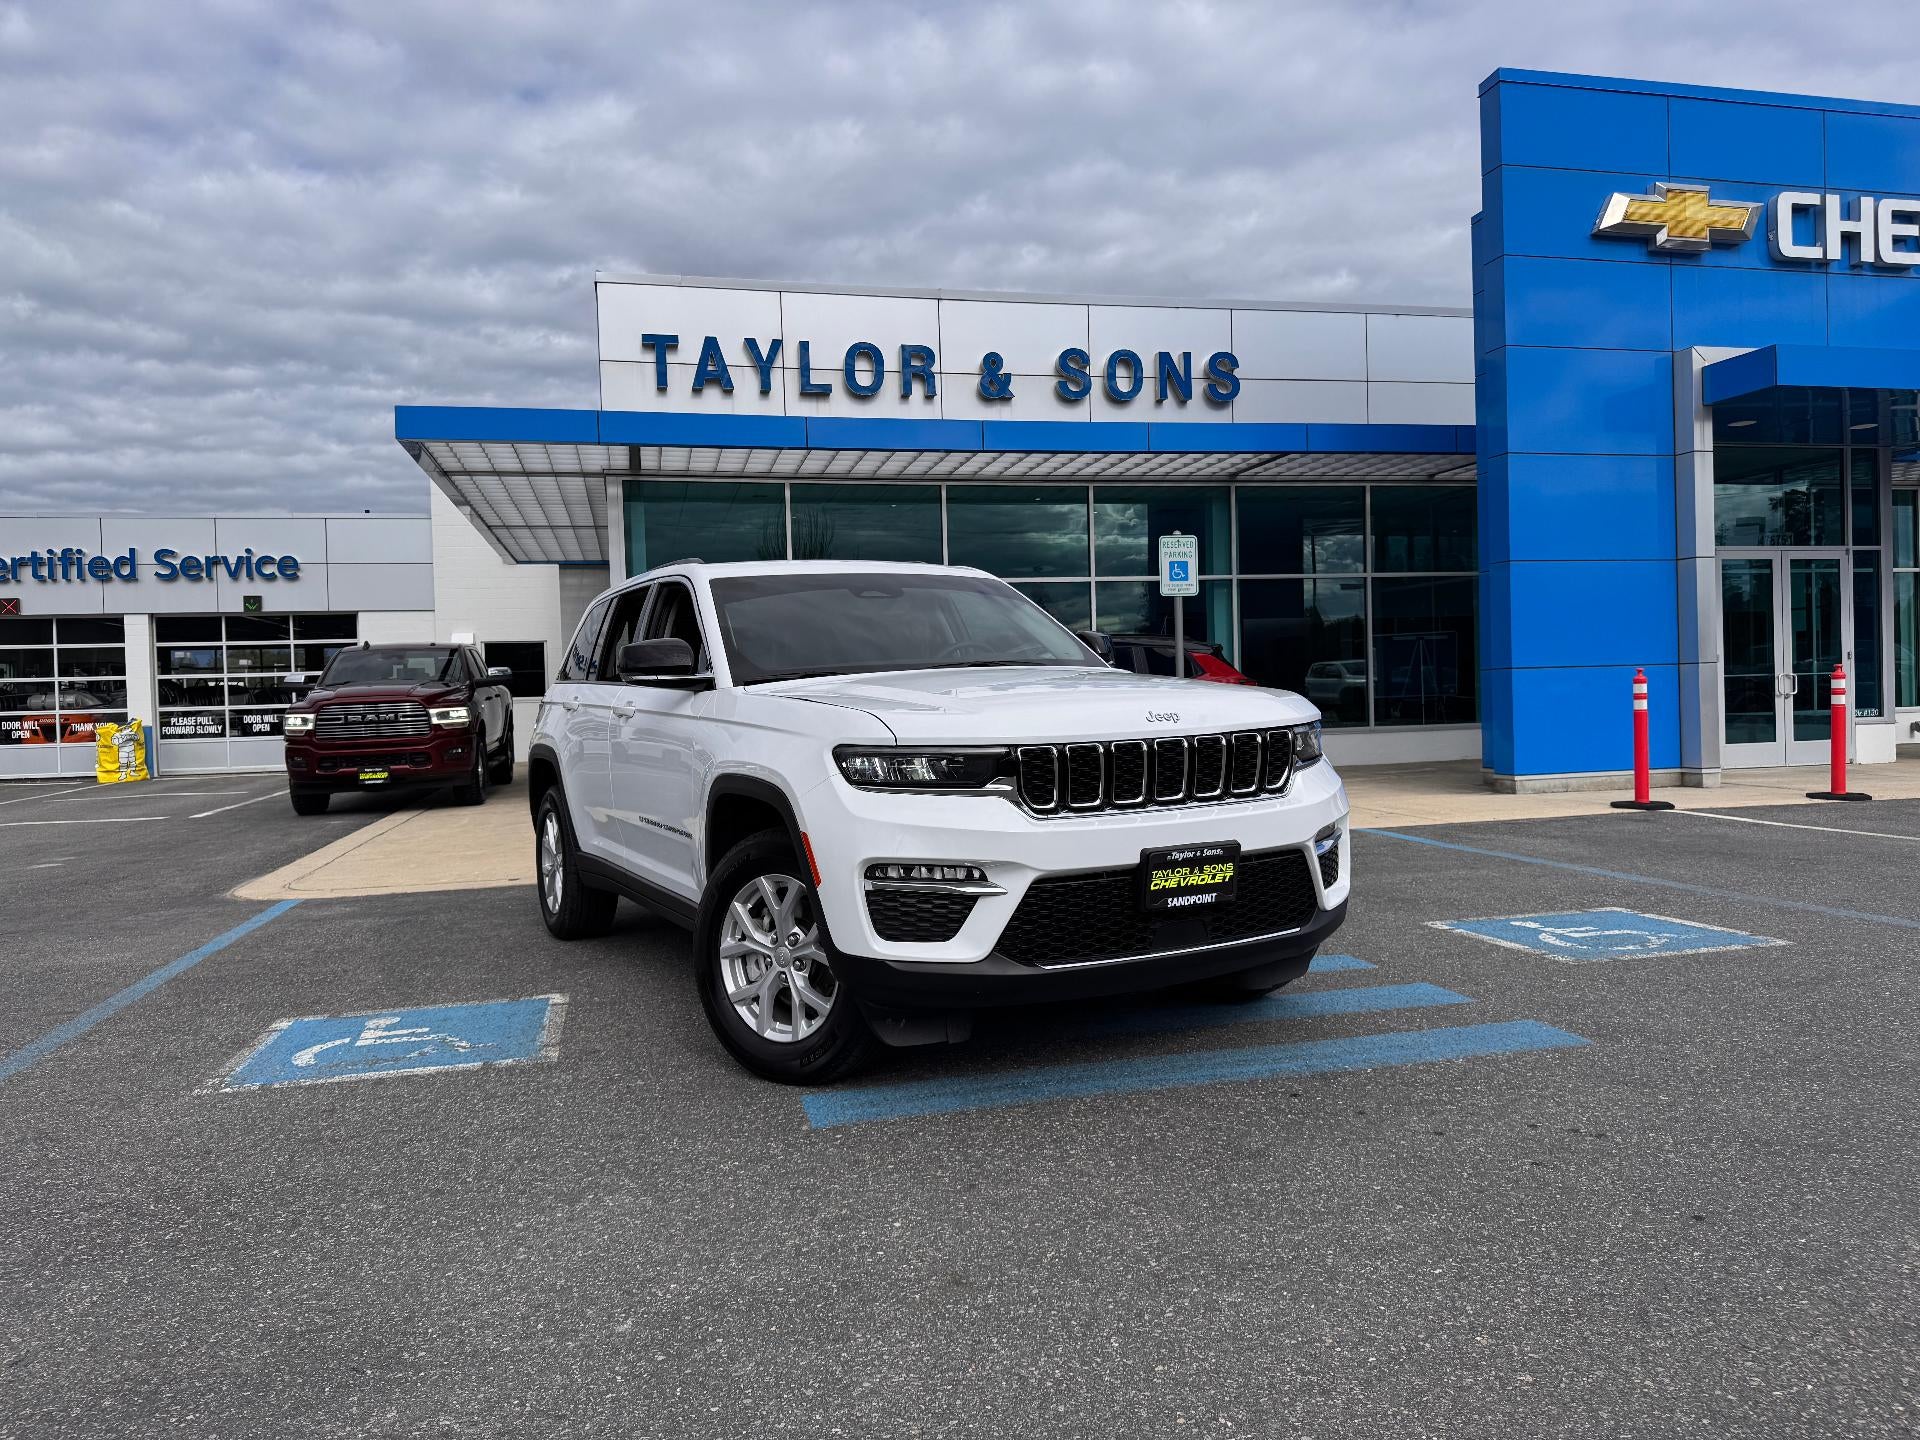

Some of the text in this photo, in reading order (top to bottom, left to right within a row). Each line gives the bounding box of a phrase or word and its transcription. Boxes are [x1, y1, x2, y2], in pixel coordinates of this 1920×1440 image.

[1770, 191, 1920, 265] CHE
[641, 333, 1242, 403] TAYLOR & SONS
[1162, 540, 1194, 549] RESERVED
[1163, 551, 1193, 559] PARKING
[152, 548, 300, 582] Service
[170, 716, 214, 726] PLEASE PULL
[243, 714, 279, 724] DOOR WILL
[343, 713, 400, 723] RAM
[1145, 709, 1181, 724] Jeep
[1, 721, 21, 730] DOOR
[22, 720, 40, 730] WILL
[71, 722, 94, 732] THANK
[162, 725, 223, 735] FORWARD SLOWLY
[252, 723, 271, 733] OPEN
[11, 730, 30, 739] OPEN
[1171, 850, 1196, 861] Taylor
[1203, 848, 1221, 857] Sons
[1151, 862, 1234, 879] TAYLOR & SONS
[1150, 872, 1234, 891] CHEVROLET
[1167, 893, 1217, 907] SANDPOINT
